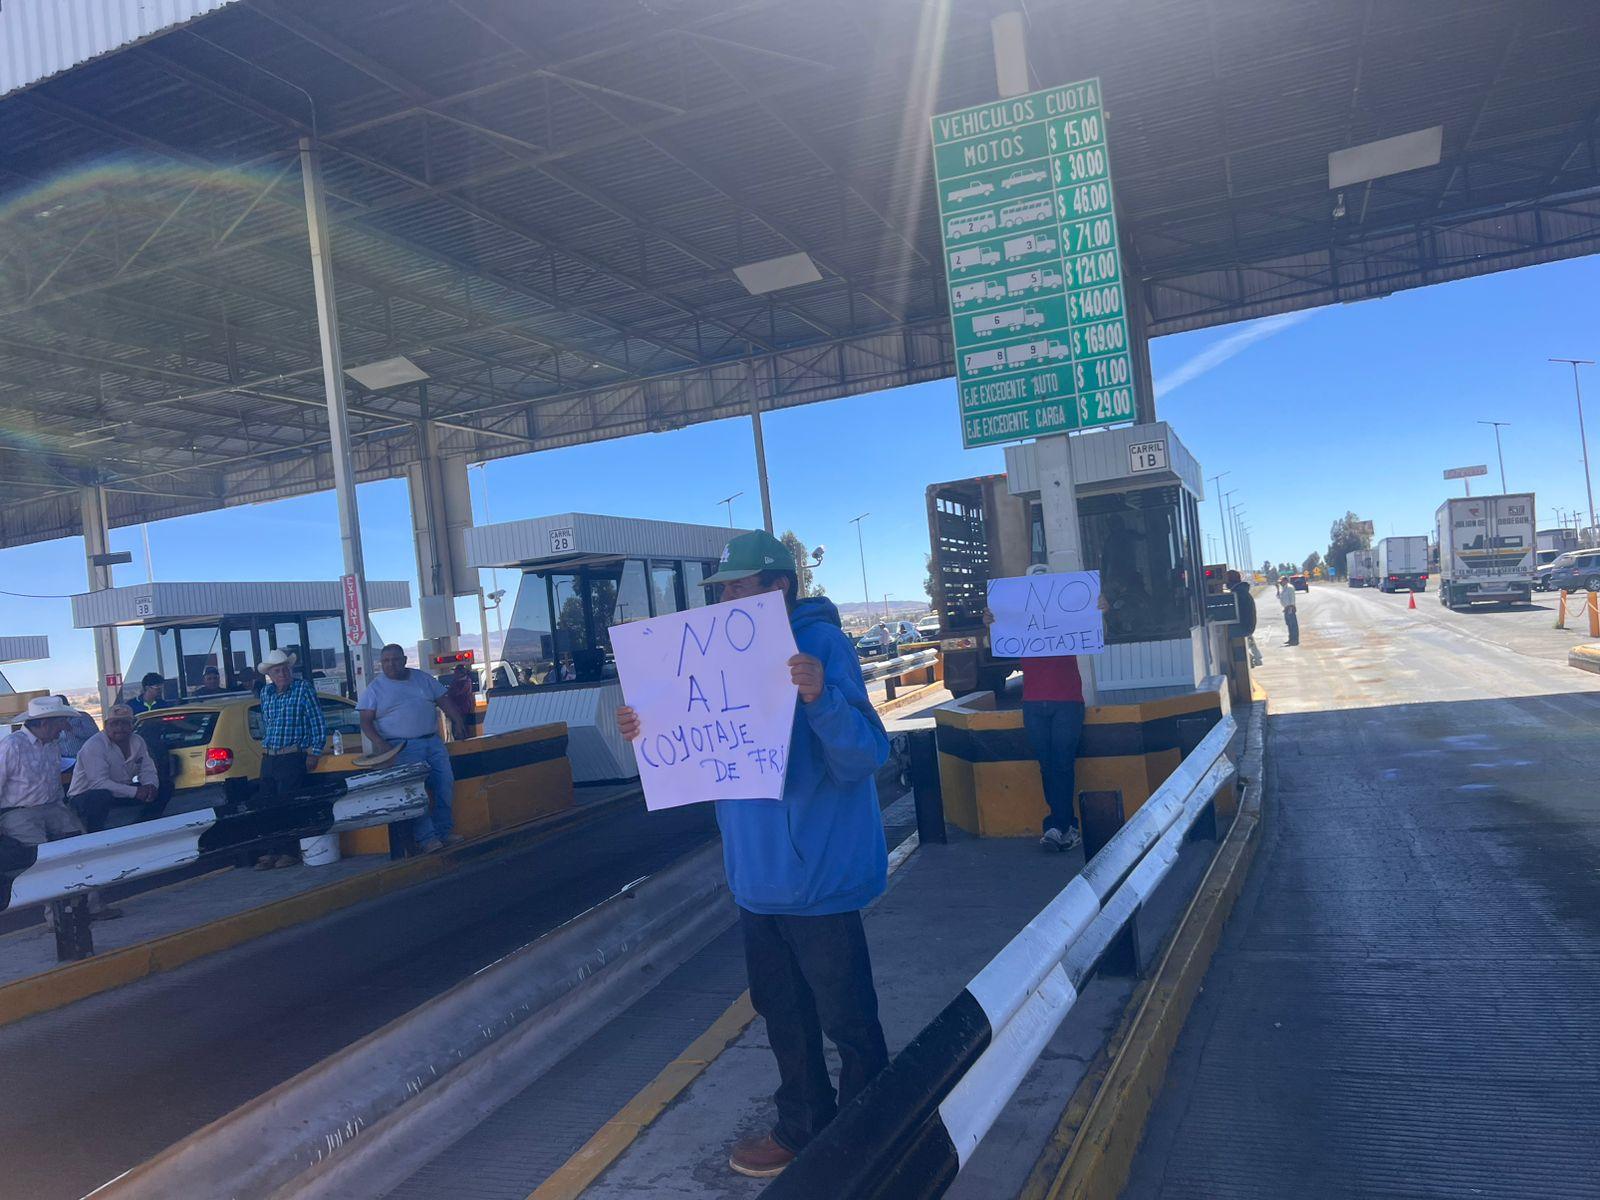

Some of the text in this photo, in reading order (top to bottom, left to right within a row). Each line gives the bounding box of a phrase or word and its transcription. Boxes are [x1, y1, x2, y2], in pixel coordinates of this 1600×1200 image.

[940, 84, 1097, 139] VEHICULOS CUOTA
[1064, 115, 1099, 147] 15.00
[964, 135, 1025, 167] MOTOS
[1069, 149, 1104, 180] 30.00
[1073, 183, 1107, 214] 46.00
[1075, 218, 1110, 251] 71.00
[1075, 252, 1115, 285] 121.00
[1079, 286, 1119, 318] 140.00
[1084, 322, 1123, 355] 169.00
[1095, 357, 1127, 386] 11.00
[964, 373, 1059, 407] EJE EXCEDENTE AUTO
[1095, 389, 1130, 419] 29.00
[966, 405, 1066, 439] EJE EXCEDENTE CARGA
[1131, 443, 1163, 455] CARRIL
[551, 530, 570, 538] CARRIL
[1027, 614, 1059, 631] AL
[688, 669, 750, 713] AL
[641, 720, 754, 767] COYOTAJE
[700, 758, 741, 783] DE
